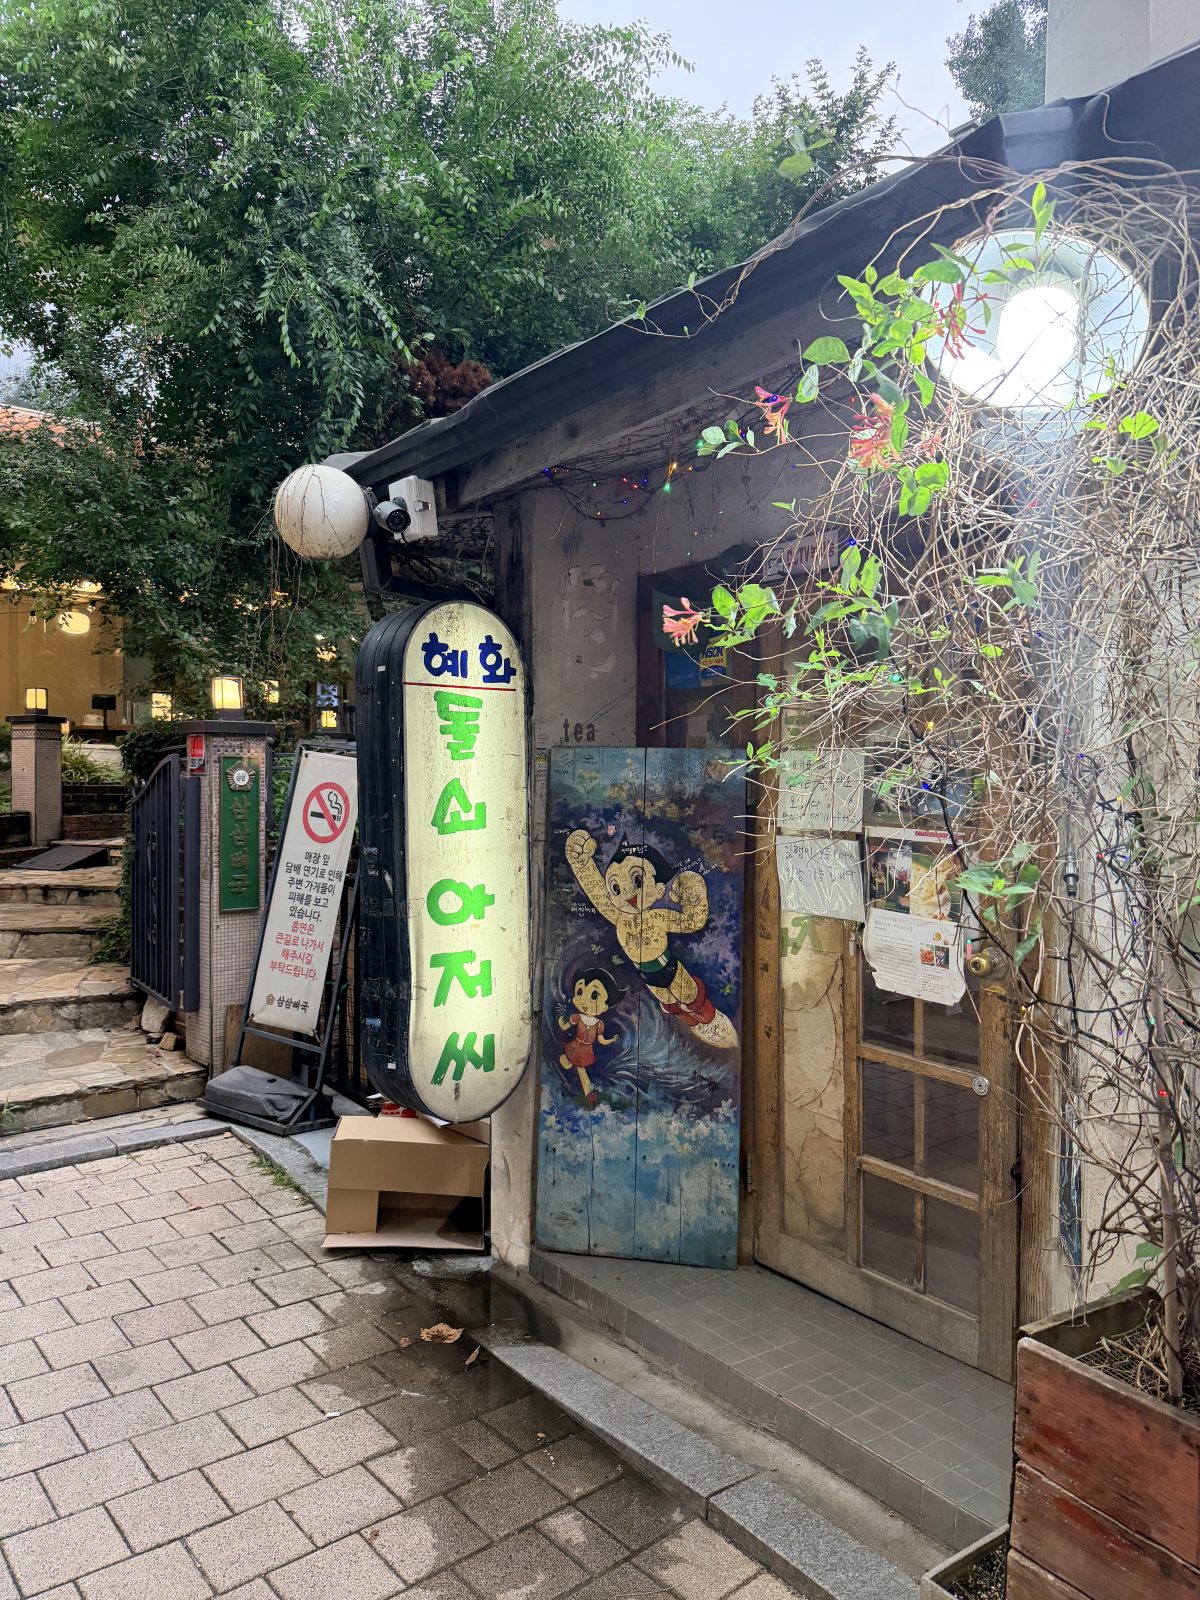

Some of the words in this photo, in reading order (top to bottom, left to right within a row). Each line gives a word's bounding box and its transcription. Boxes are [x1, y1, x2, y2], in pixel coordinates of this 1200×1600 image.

[421, 632, 517, 684] 혜화
[562, 718, 596, 743] tea
[227, 794, 252, 900] 삼삼뼈국
[785, 843, 813, 859] 일행이
[305, 851, 321, 865] 매장
[322, 854, 331, 867] 앞
[285, 861, 302, 876] 담배
[303, 865, 327, 879] 연기로
[328, 869, 344, 883] 인해
[287, 876, 304, 890] 주변
[304, 880, 336, 896] 가게들이
[427, 690, 496, 1086] 돌쇠아저씨
[288, 891, 313, 906] 피해를
[313, 896, 329, 908] 보고
[288, 905, 322, 922] 있습니다.
[291, 920, 316, 936] 흡연은
[275, 932, 300, 947] 큰길로
[301, 937, 325, 953] 나가서
[281, 947, 314, 966] 해주시길
[268, 960, 318, 981] 부탁드립니다.
[276, 995, 310, 1013] 삼삼뼈국
